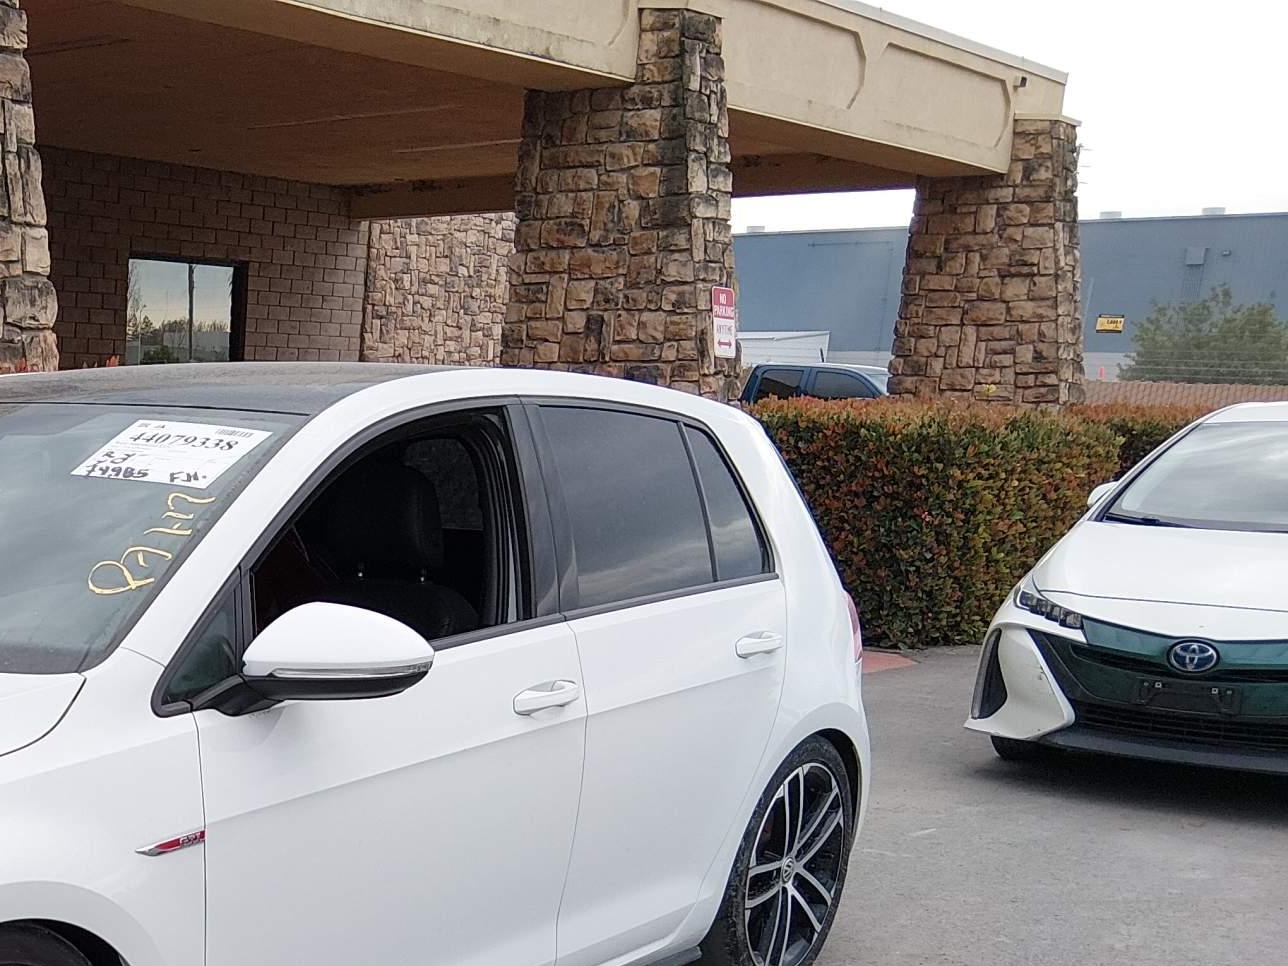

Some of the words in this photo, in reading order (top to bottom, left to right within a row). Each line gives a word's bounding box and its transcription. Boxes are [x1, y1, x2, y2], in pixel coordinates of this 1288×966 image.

[719, 292, 727, 305] NO
[713, 304, 735, 318] PARKING
[129, 431, 239, 451] 44079338
